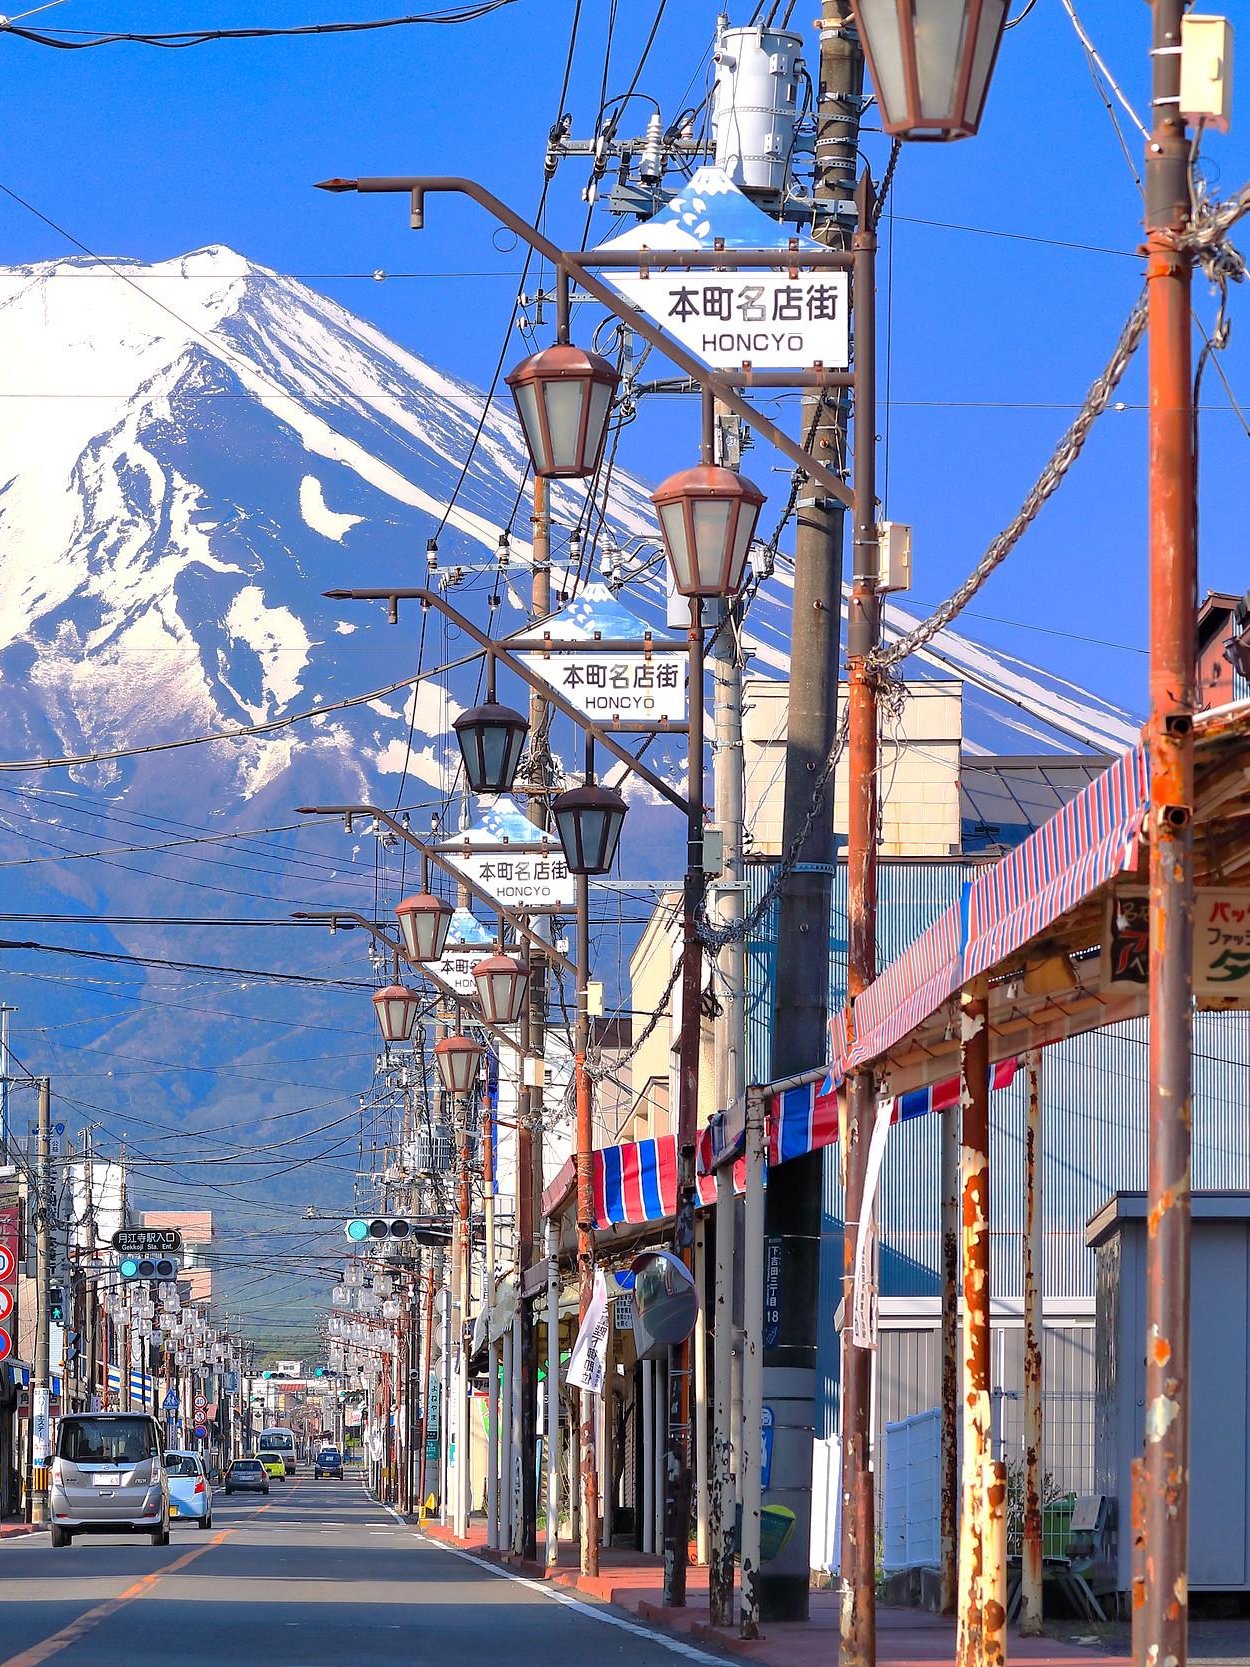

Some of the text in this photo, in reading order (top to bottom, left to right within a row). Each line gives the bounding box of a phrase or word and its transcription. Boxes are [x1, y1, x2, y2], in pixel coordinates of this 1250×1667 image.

[668, 285, 838, 322] 本町名店街
[563, 664, 678, 689] 本町名店街
[479, 861, 568, 881] 本町名店街
[119, 1233, 174, 1243] 月江寺駅入口
[770, 1246, 778, 1307] 下吉田三丁目
[767, 1311, 779, 1322] 18
